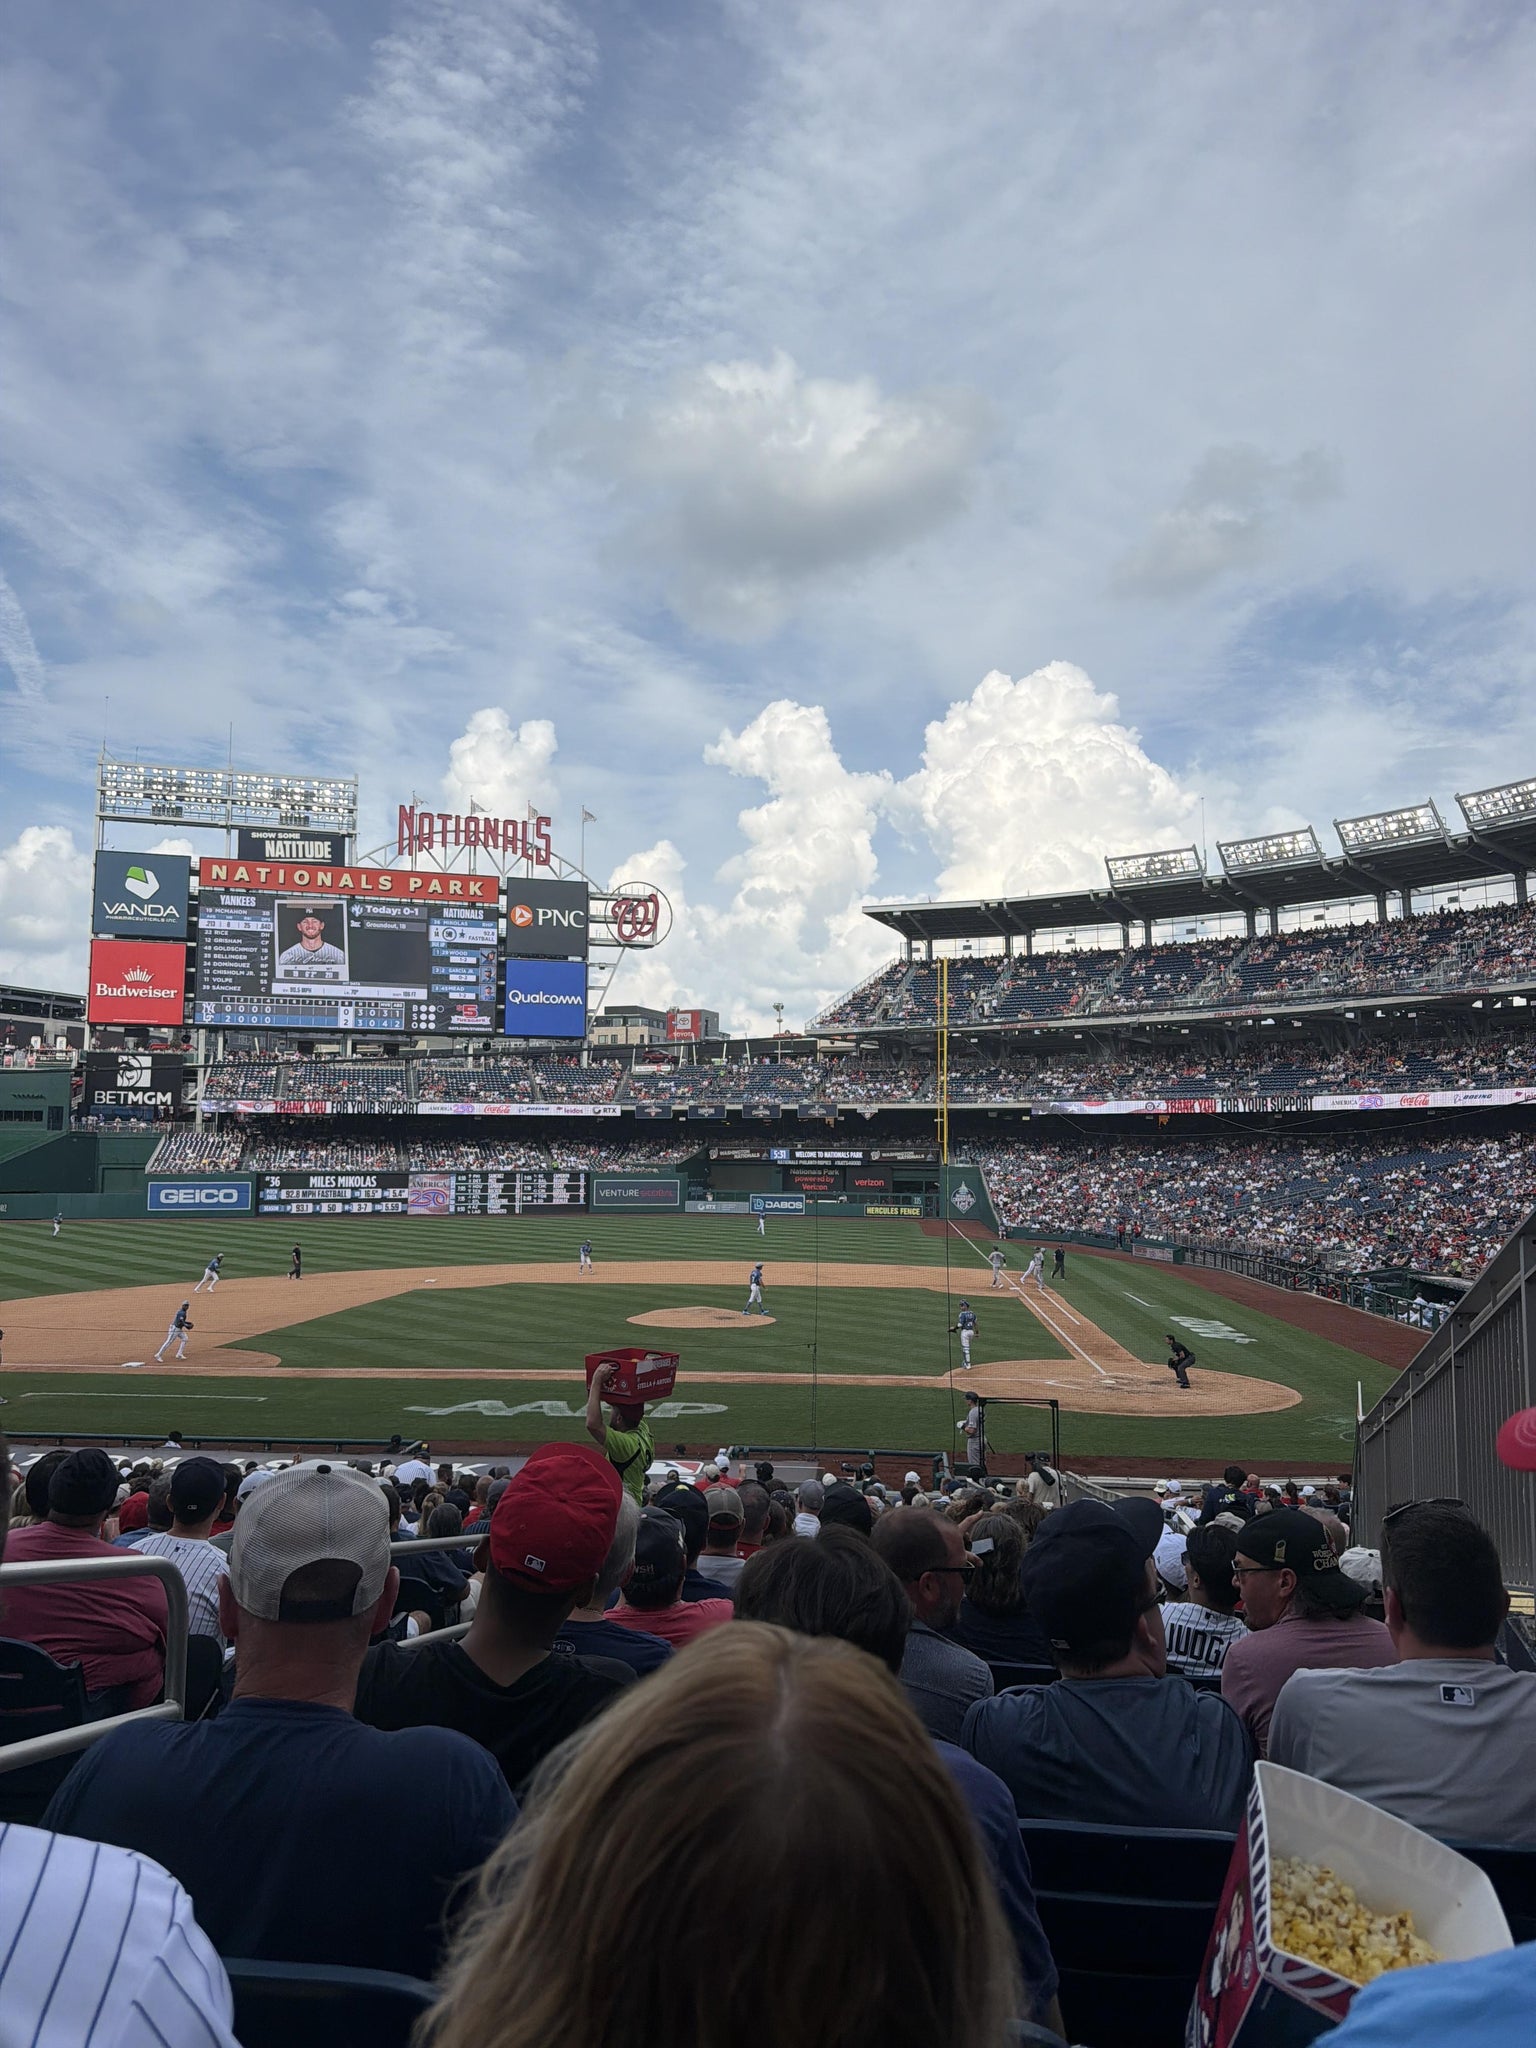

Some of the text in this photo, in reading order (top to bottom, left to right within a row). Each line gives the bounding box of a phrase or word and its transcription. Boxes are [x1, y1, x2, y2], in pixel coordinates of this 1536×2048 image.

[398, 805, 551, 865] NATIONALS
[265, 840, 332, 858] NATITUDE
[211, 865, 484, 896] NATIONALS PARK
[220, 895, 256, 907] YANKEES
[103, 902, 180, 918] VANDA
[365, 905, 419, 916] Today: 0-1
[443, 908, 484, 920] NATIONALS
[536, 908, 585, 928] PNC
[96, 983, 178, 998] Budweiser
[509, 990, 582, 1005] Qualcomm
[343, 1008, 349, 1016] 0
[264, 1016, 271, 1024] 0
[94, 1091, 172, 1105] BETMGM
[274, 1100, 418, 1114] THANK YOU FOR YOUR SUPPORT
[564, 1106, 583, 1114] leidos
[1166, 1096, 1313, 1113] THANK YOU FOR YOUR SUPPORT
[774, 1150, 786, 1159] 5:31
[265, 1176, 377, 1188] #36 MILES MIKOLAS
[855, 1178, 884, 1186] verizon
[160, 1189, 238, 1204] GEICO
[285, 1190, 300, 1198] 92.8
[302, 1190, 317, 1198] MPH
[317, 1190, 347, 1198] FASTBALL
[410, 1188, 448, 1206] 250
[600, 1189, 639, 1197] VENTURE
[296, 1204, 308, 1212] 93.1
[385, 1203, 399, 1211] 5.59
[765, 1201, 803, 1209] DABOS
[867, 1207, 920, 1216] HERCULES FENCE
[637, 1381, 652, 1390] STELLA
[1166, 1622, 1232, 1667] JUDG
